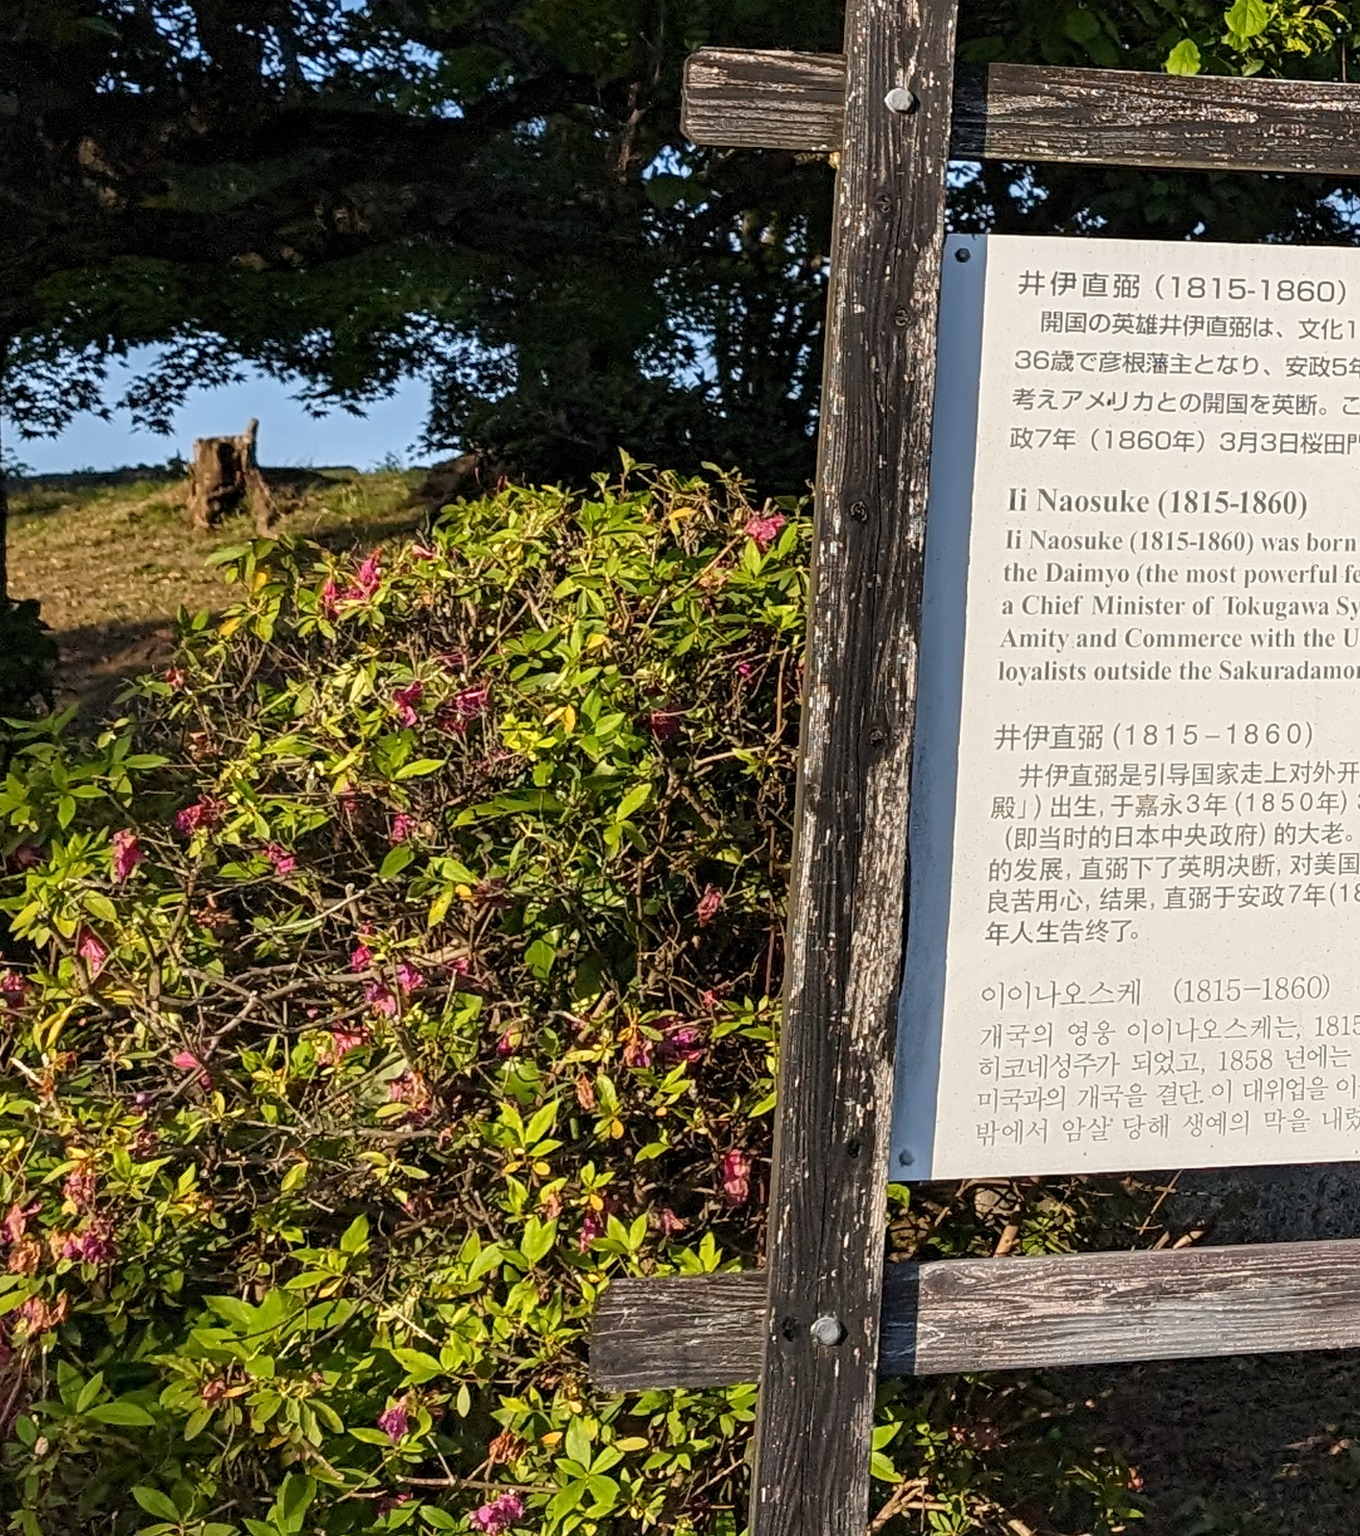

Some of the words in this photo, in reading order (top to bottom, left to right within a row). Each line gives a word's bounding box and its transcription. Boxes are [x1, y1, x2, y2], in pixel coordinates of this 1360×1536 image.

[1005, 486, 1028, 513] Ii
[1034, 486, 1151, 514] Naosuke
[1156, 488, 1308, 520] (1815-1860)
[1004, 528, 1023, 551] Ii
[1027, 528, 1124, 552] Naosuke
[1128, 529, 1255, 558] (1815-1860)
[1259, 535, 1301, 553] was
[1305, 530, 1357, 553] born
[1002, 561, 1039, 583] the
[1044, 560, 1131, 589] Daimyo
[1134, 561, 1180, 589] (the
[1185, 564, 1238, 585] most
[1242, 562, 1338, 590] powerful
[1000, 598, 1015, 616] a
[1020, 593, 1085, 616] Chief
[1089, 593, 1187, 617] Minister
[1190, 593, 1216, 617] of
[1221, 594, 1330, 623] Tokugawa
[998, 626, 1071, 655] Amity
[1074, 626, 1118, 649] and
[1123, 626, 1244, 649] Commerce
[1248, 626, 1296, 648] with
[1302, 626, 1337, 648] the
[997, 658, 1088, 688] loyalists
[1092, 658, 1173, 682] outside
[1178, 659, 1213, 681] the
[979, 976, 1142, 1012] 이이나오스케
[978, 1020, 1054, 1051] 개국의
[1066, 1018, 1117, 1048] 영웅
[1125, 1013, 1302, 1045] 이이나오스케는,
[976, 1049, 1122, 1083] 히코네성주가
[1129, 1048, 1207, 1077] 되었고,
[1217, 1047, 1274, 1073] 1858
[1283, 1042, 1353, 1071] 년에는
[975, 1083, 1067, 1115] 미국과의
[1076, 1080, 1149, 1111] 개국을
[1154, 1078, 1205, 1107] 결단.
[1209, 1077, 1233, 1105] 이
[1241, 1074, 1330, 1104] 대위업을
[974, 1116, 1049, 1148] 밖에서
[1121, 1111, 1170, 1141] 당해
[1180, 1108, 1250, 1139] 생예의
[1262, 1106, 1312, 1135] 막을
